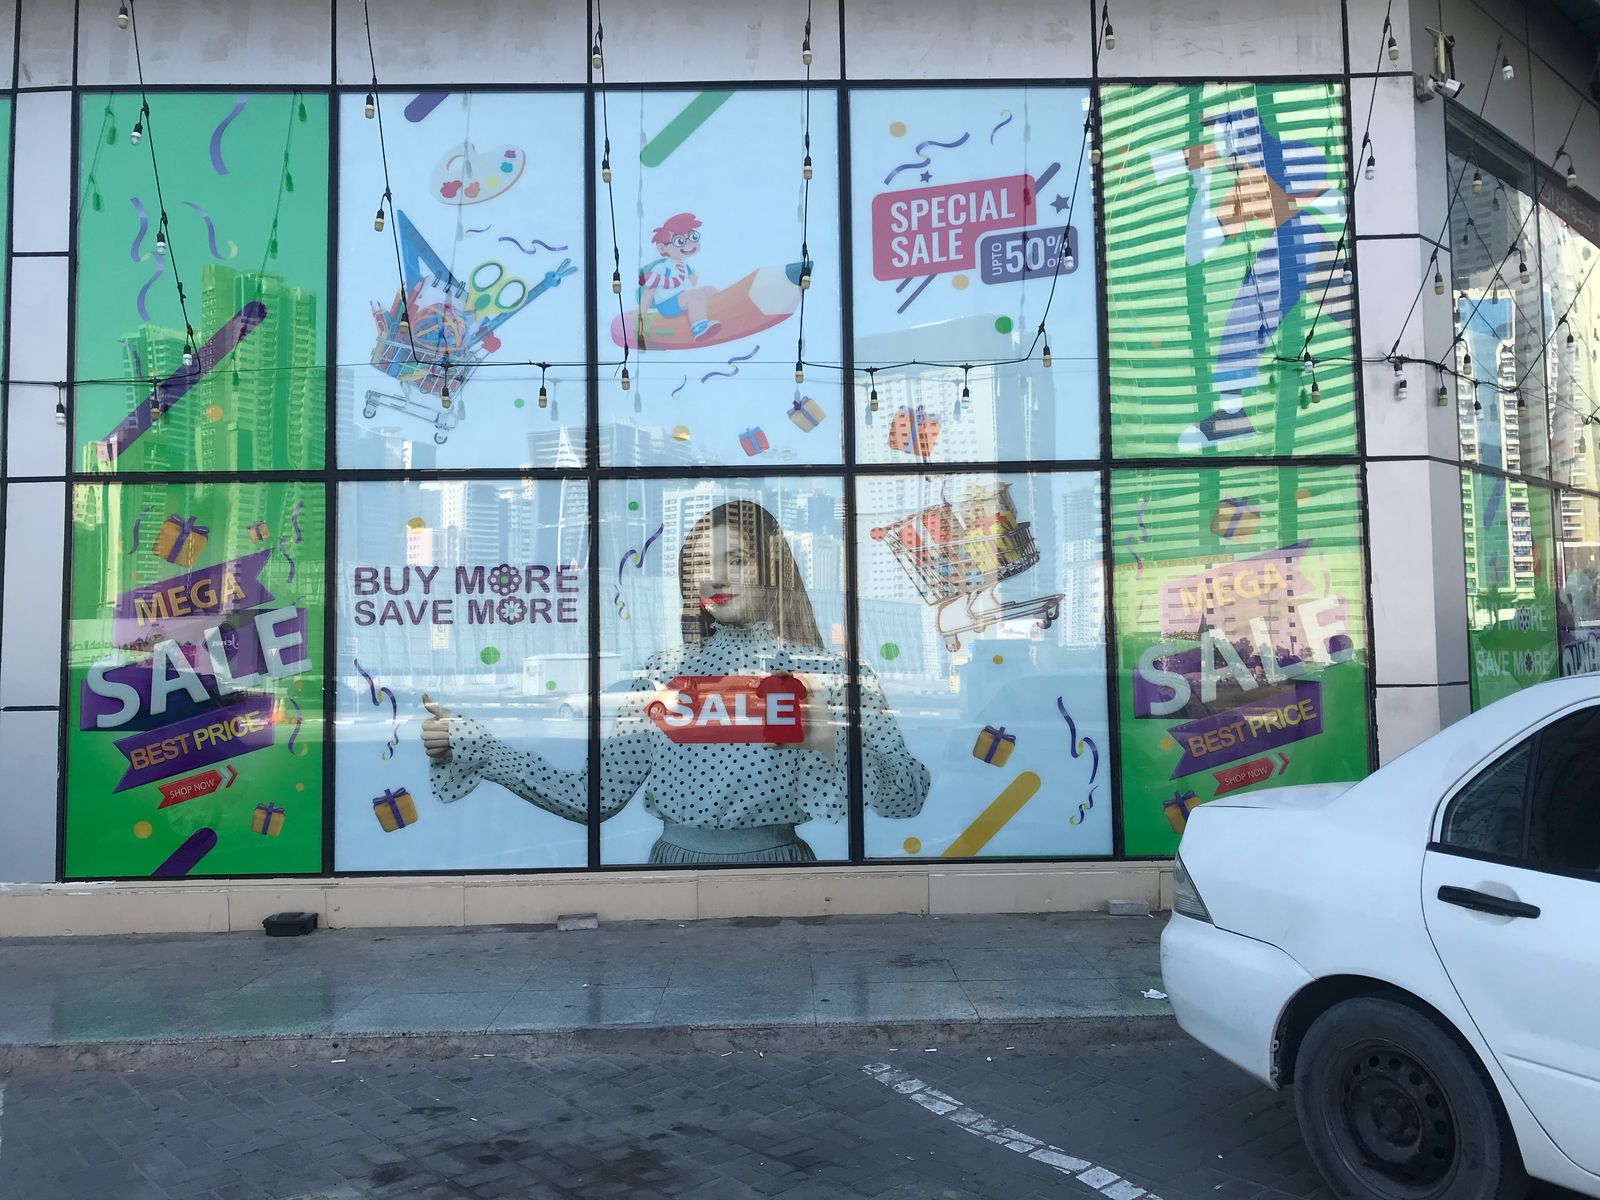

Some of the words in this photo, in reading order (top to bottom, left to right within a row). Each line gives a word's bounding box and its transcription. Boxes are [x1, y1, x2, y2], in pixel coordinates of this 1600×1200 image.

[890, 188, 1016, 233] SPECIAL
[891, 229, 964, 268] SALE
[992, 242, 1002, 276] UPTO
[133, 571, 246, 627] MEGA
[354, 565, 440, 596] BUY
[455, 563, 580, 597] MORE
[1179, 561, 1288, 617] MEGA
[353, 599, 454, 627] SAVE
[467, 596, 578, 626] MORE
[86, 605, 313, 729] SALE
[1138, 594, 1355, 716] SALE
[1476, 650, 1510, 677] SAVE
[663, 692, 796, 727] SALE
[1188, 722, 1245, 759] BEST
[1248, 698, 1317, 738] PRICE
[129, 733, 189, 771] BEST
[193, 710, 265, 751] PRICE
[169, 784, 193, 800] SHOP
[194, 778, 216, 794] NOW
[1224, 772, 1247, 787] SHOP
[1247, 766, 1269, 782] NOW
